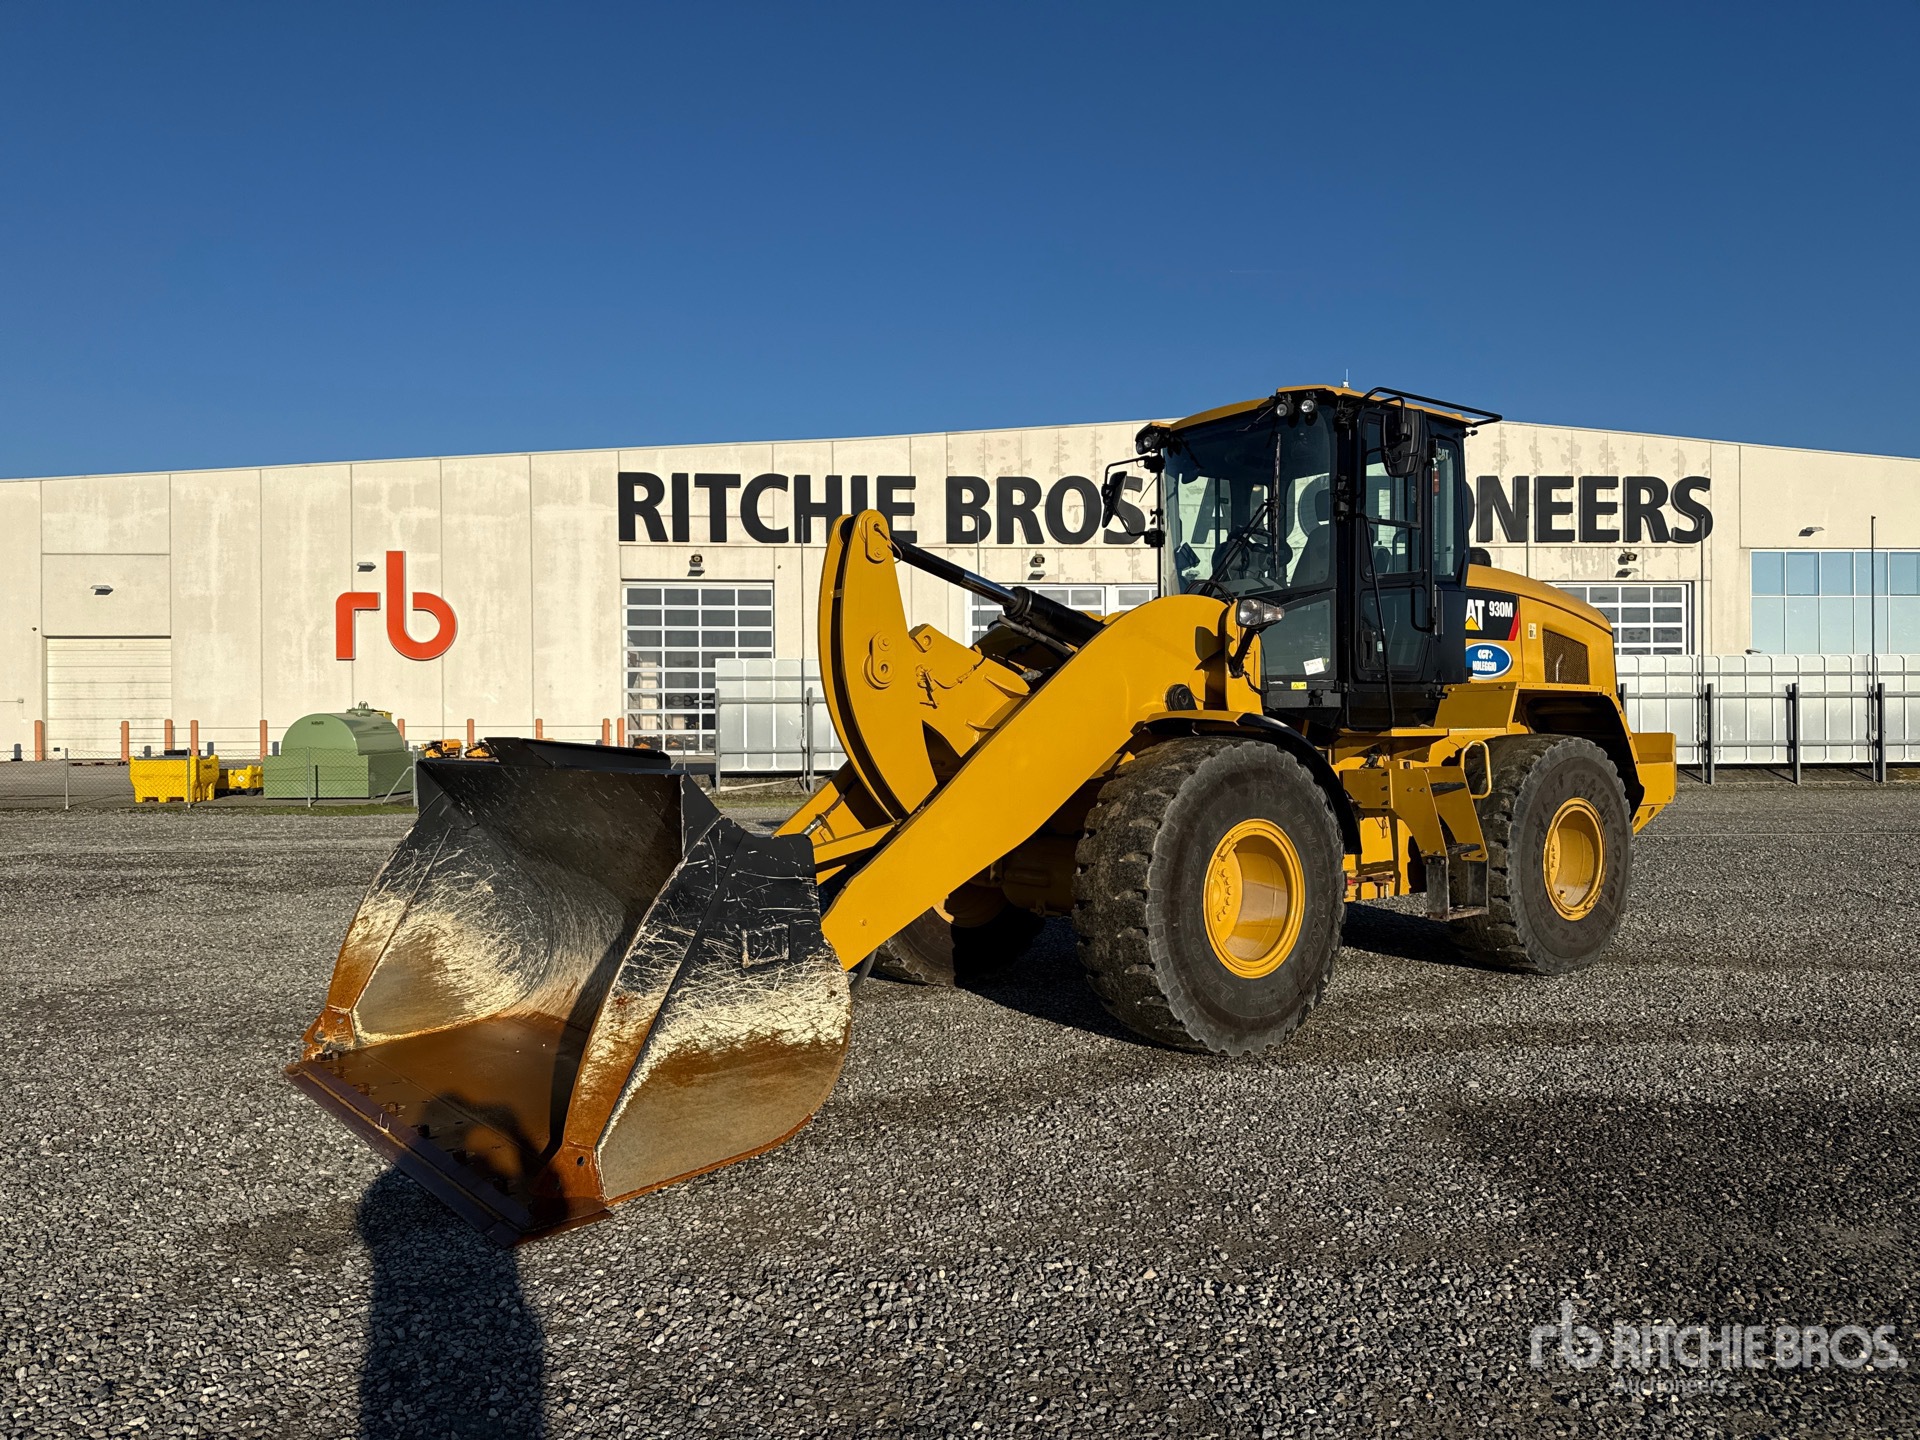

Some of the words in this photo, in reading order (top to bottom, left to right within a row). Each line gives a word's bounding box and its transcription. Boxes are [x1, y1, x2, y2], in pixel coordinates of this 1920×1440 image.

[618, 471, 917, 544] RITCHIE
[336, 551, 458, 661] rb
[1465, 599, 1485, 631] AT
[1489, 601, 1513, 618] 930M
[1473, 661, 1497, 672] NOLEGGIO
